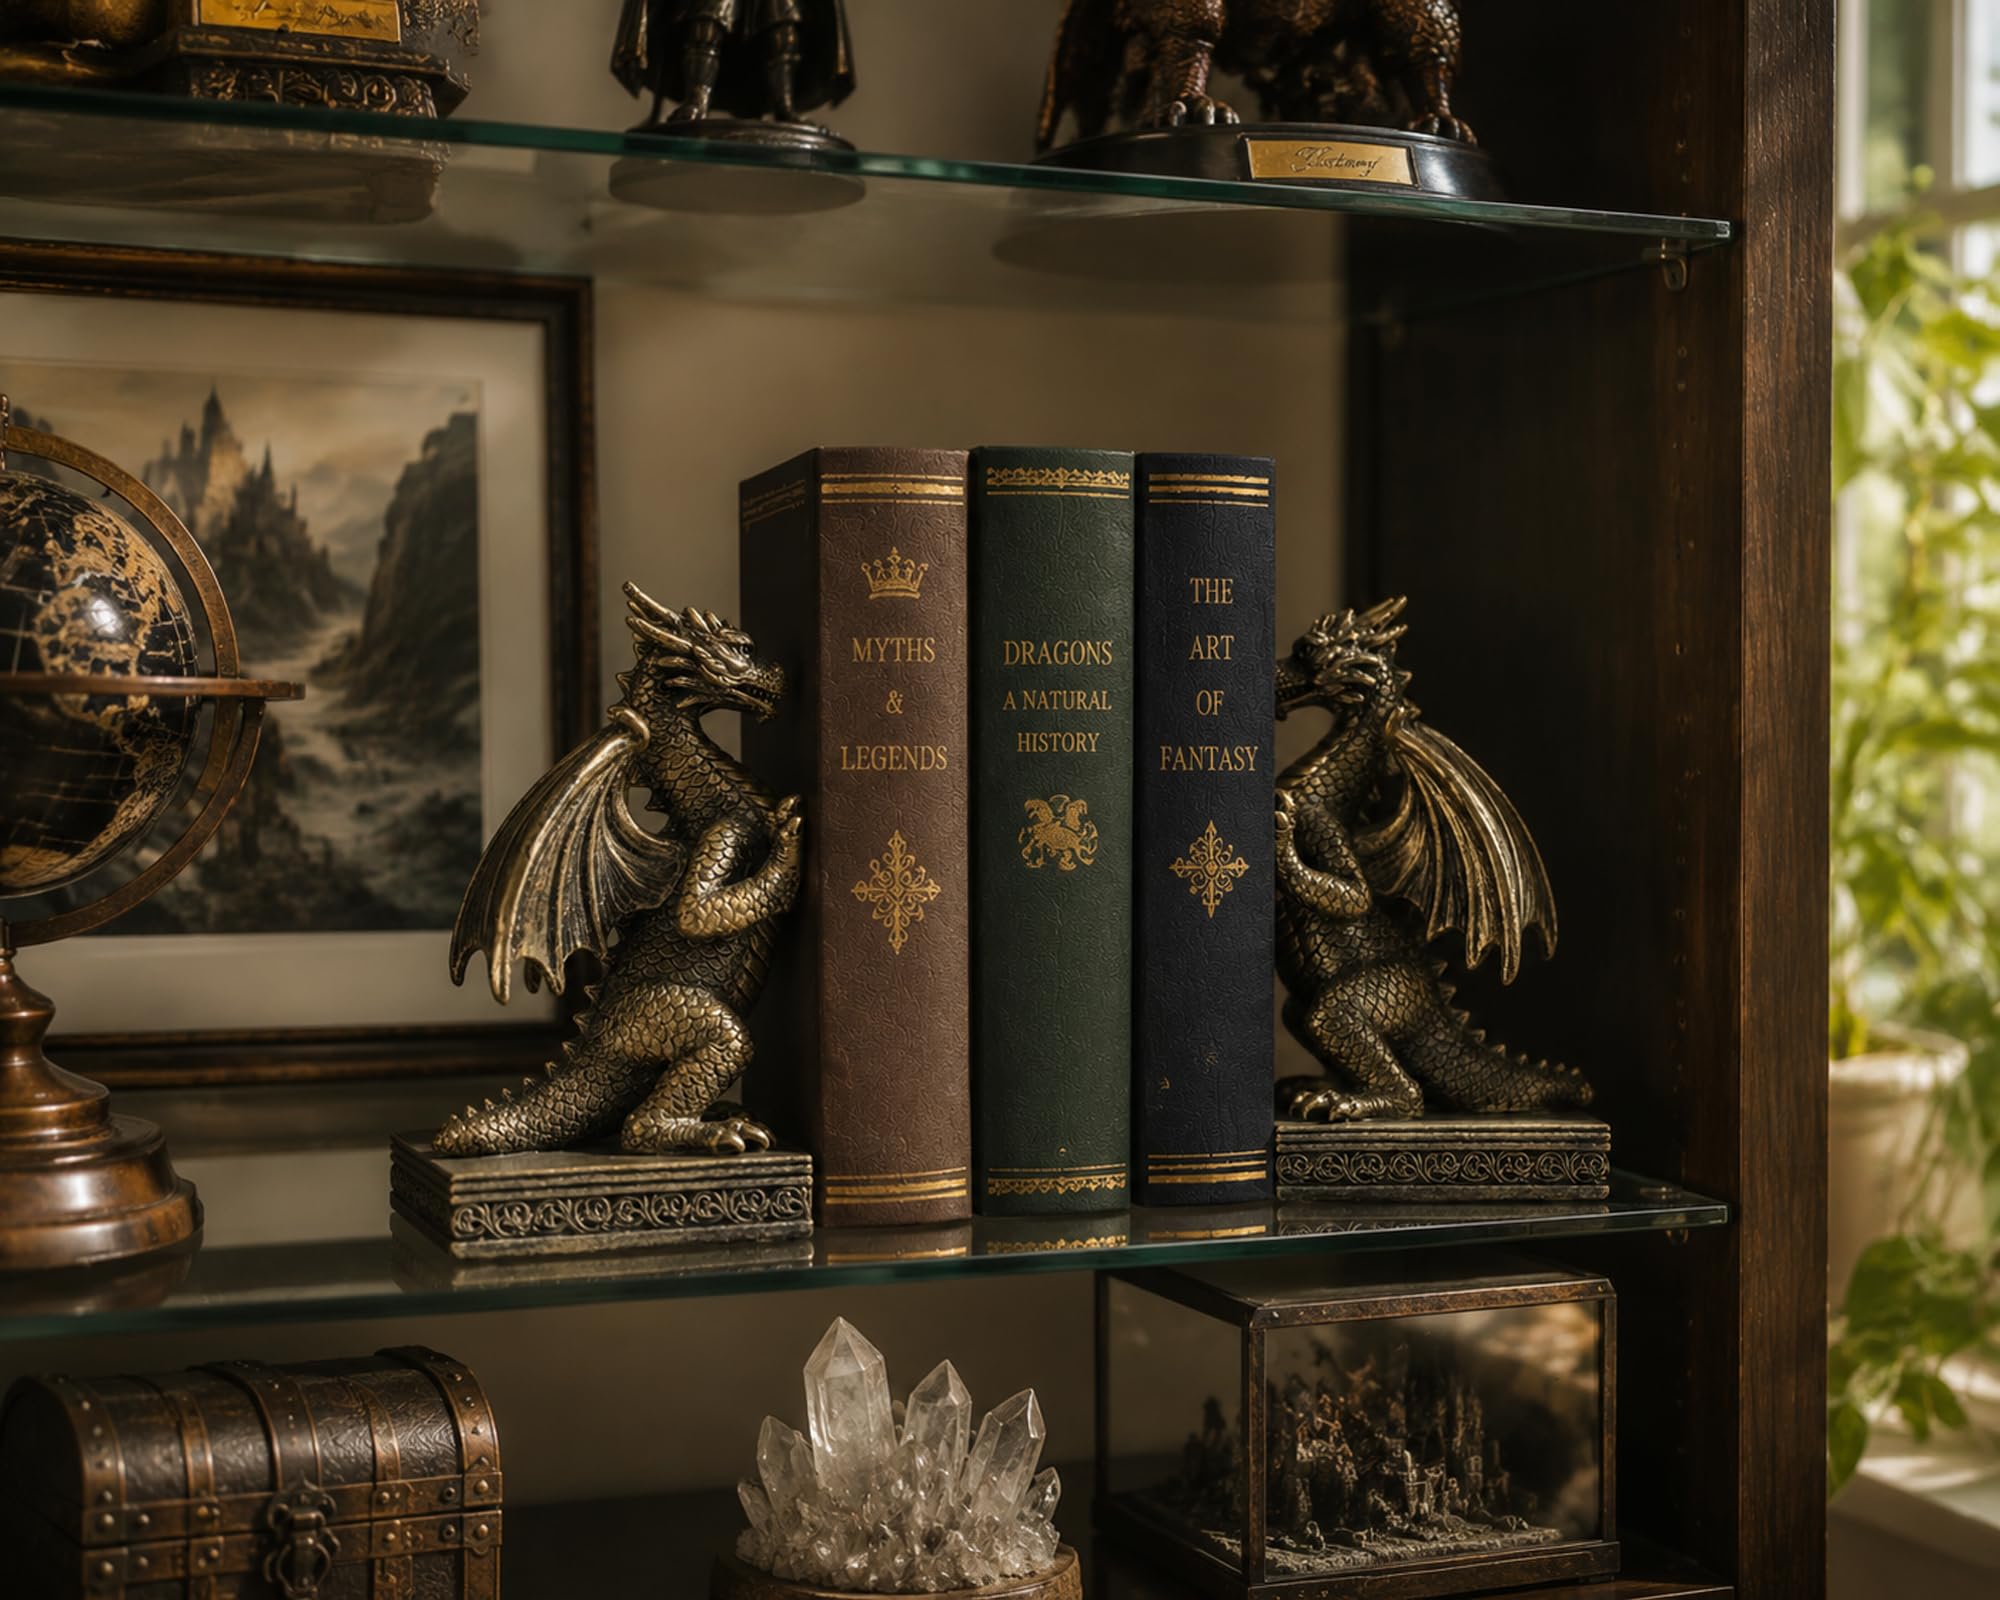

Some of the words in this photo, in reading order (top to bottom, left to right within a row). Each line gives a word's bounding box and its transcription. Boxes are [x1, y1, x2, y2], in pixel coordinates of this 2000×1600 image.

[1190, 577, 1234, 605] THE
[852, 636, 936, 664] MYTHS
[1003, 639, 1114, 667] DRAGONS
[1188, 634, 1235, 661] ART
[885, 689, 904, 715] &
[1003, 690, 1017, 711] A
[1023, 689, 1113, 711] NATURAL
[1195, 689, 1225, 716] OF
[1017, 731, 1101, 753] HISTORY
[840, 744, 949, 772] LEGENDS
[1160, 745, 1260, 772] FANTASY
